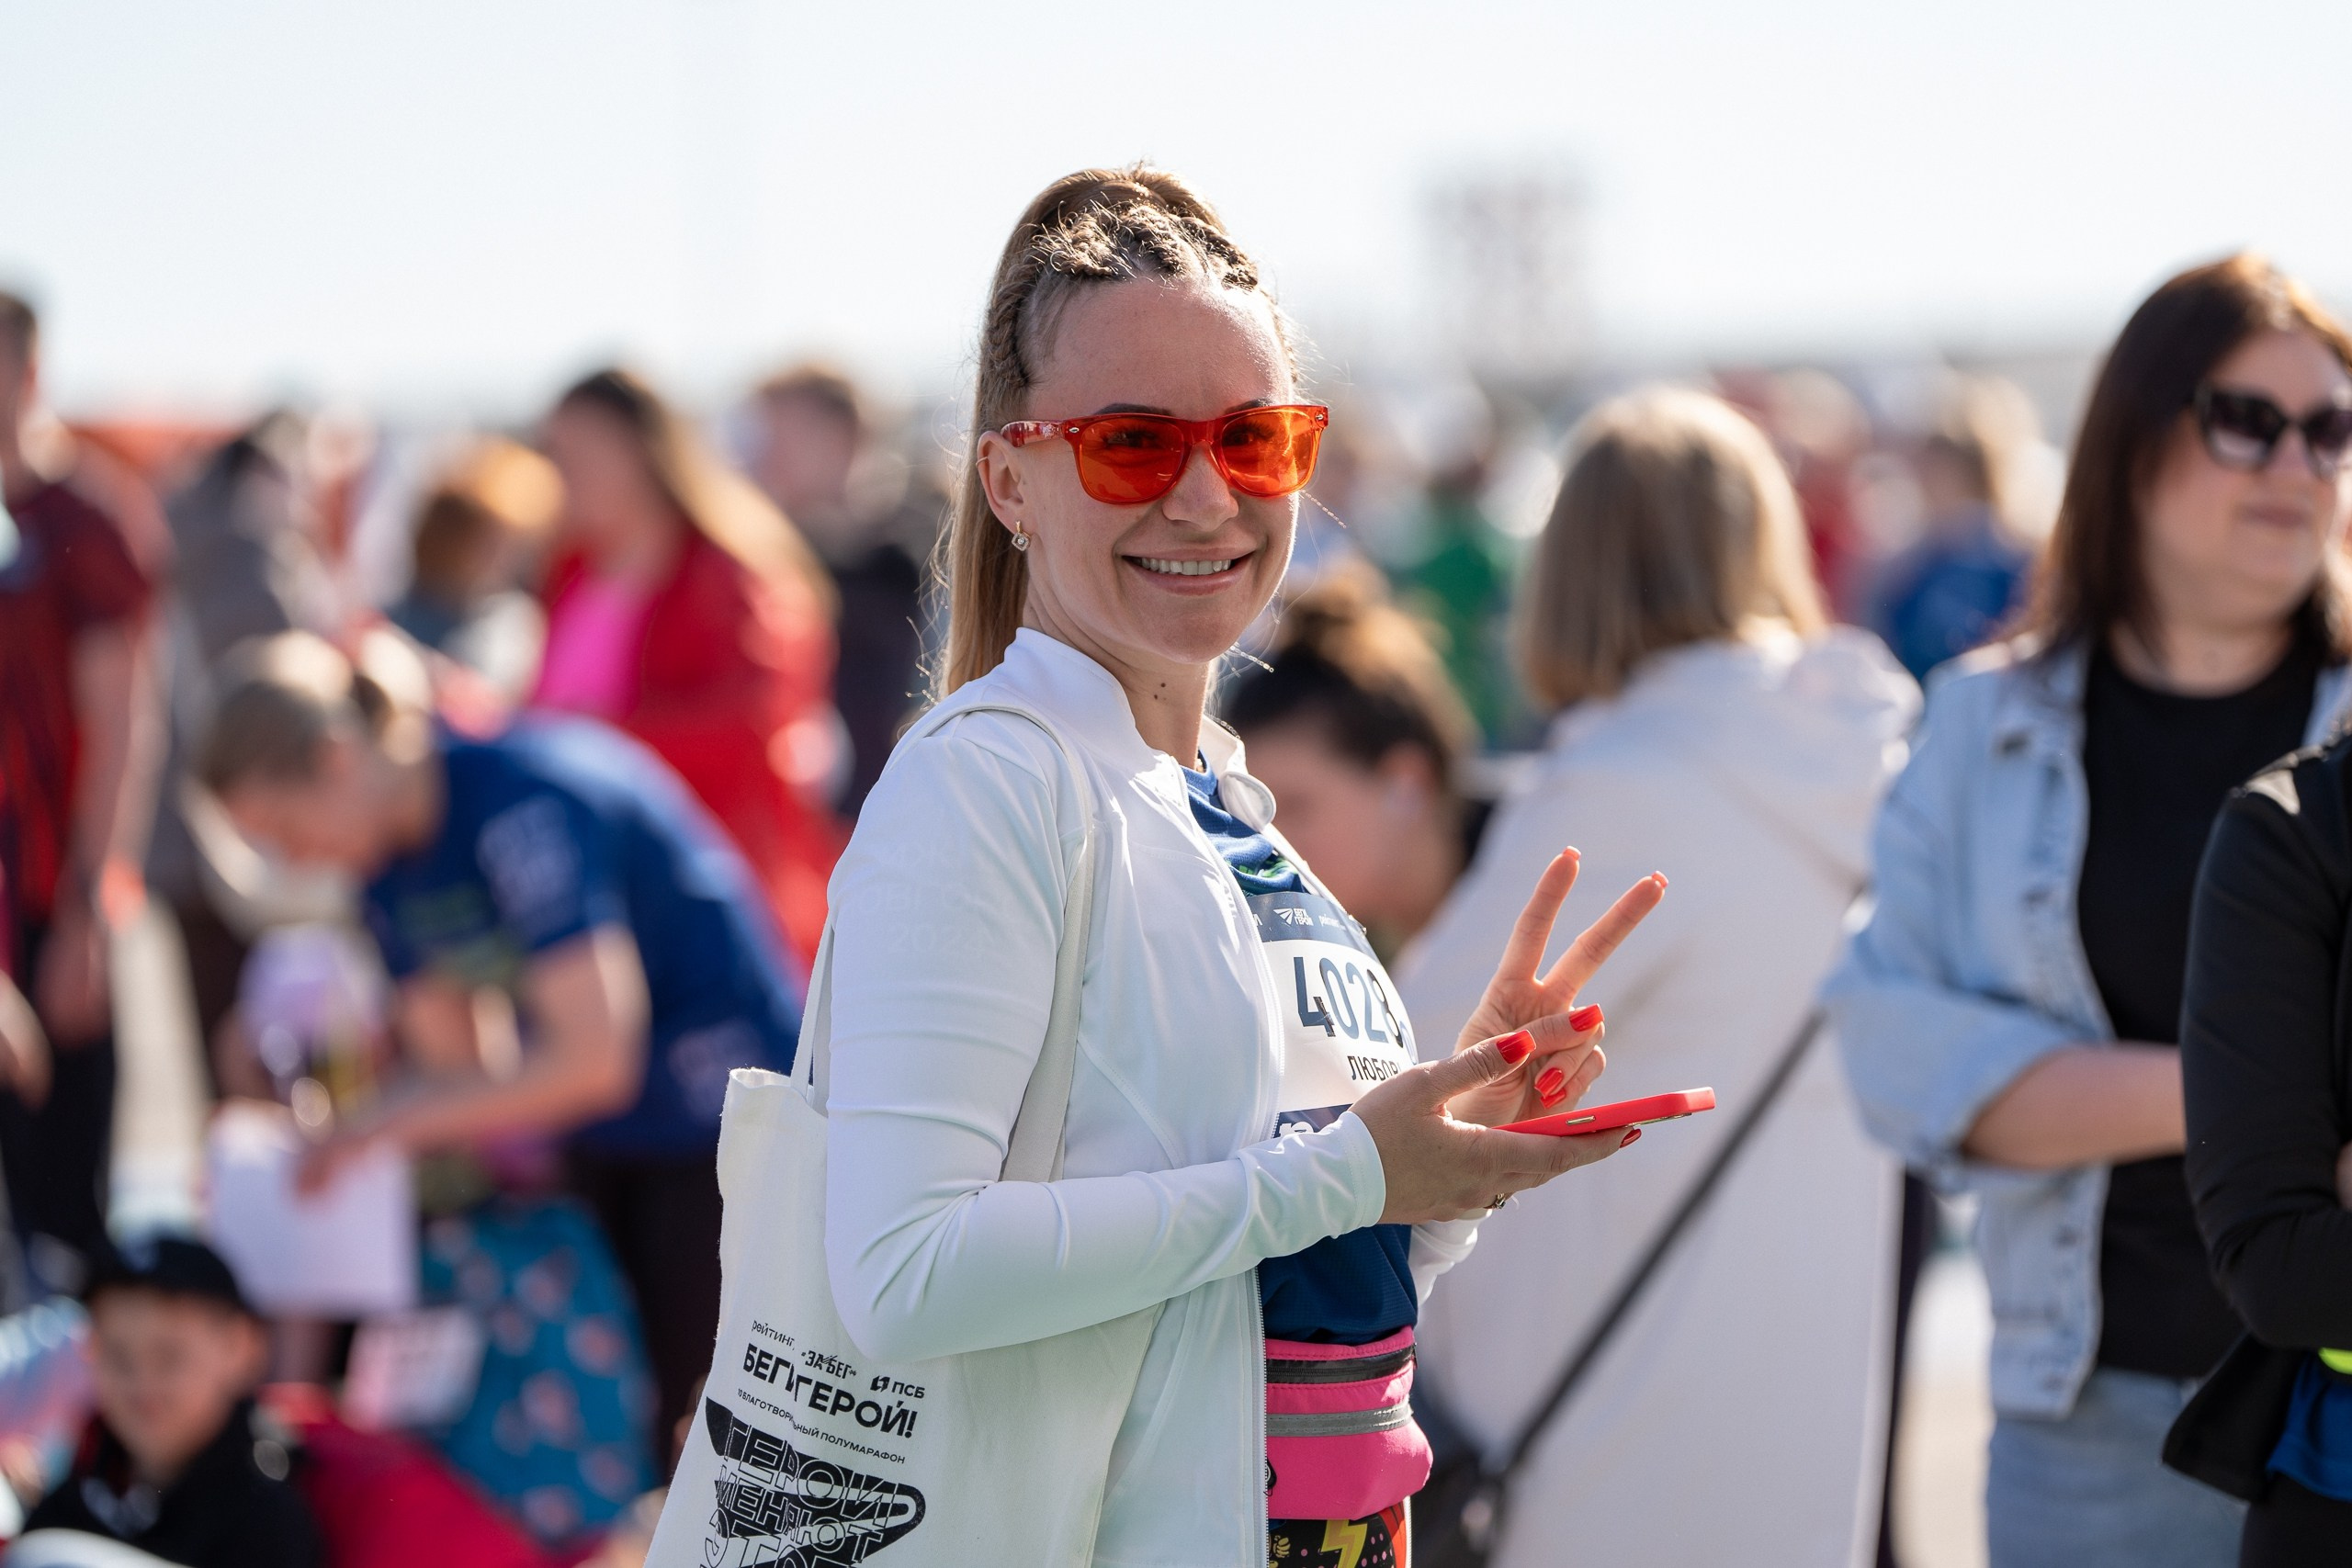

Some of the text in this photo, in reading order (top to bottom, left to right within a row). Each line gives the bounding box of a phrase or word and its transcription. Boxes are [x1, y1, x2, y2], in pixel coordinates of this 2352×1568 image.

[1294, 956, 1404, 1049] 4028
[1347, 1055, 1401, 1081] ЛЮБОВ
[794, 1374, 918, 1438] ГЕРОЙ!
[891, 1381, 925, 1399] ПСБ
[820, 1432, 906, 1464] ПОЛУМАРАФОН
